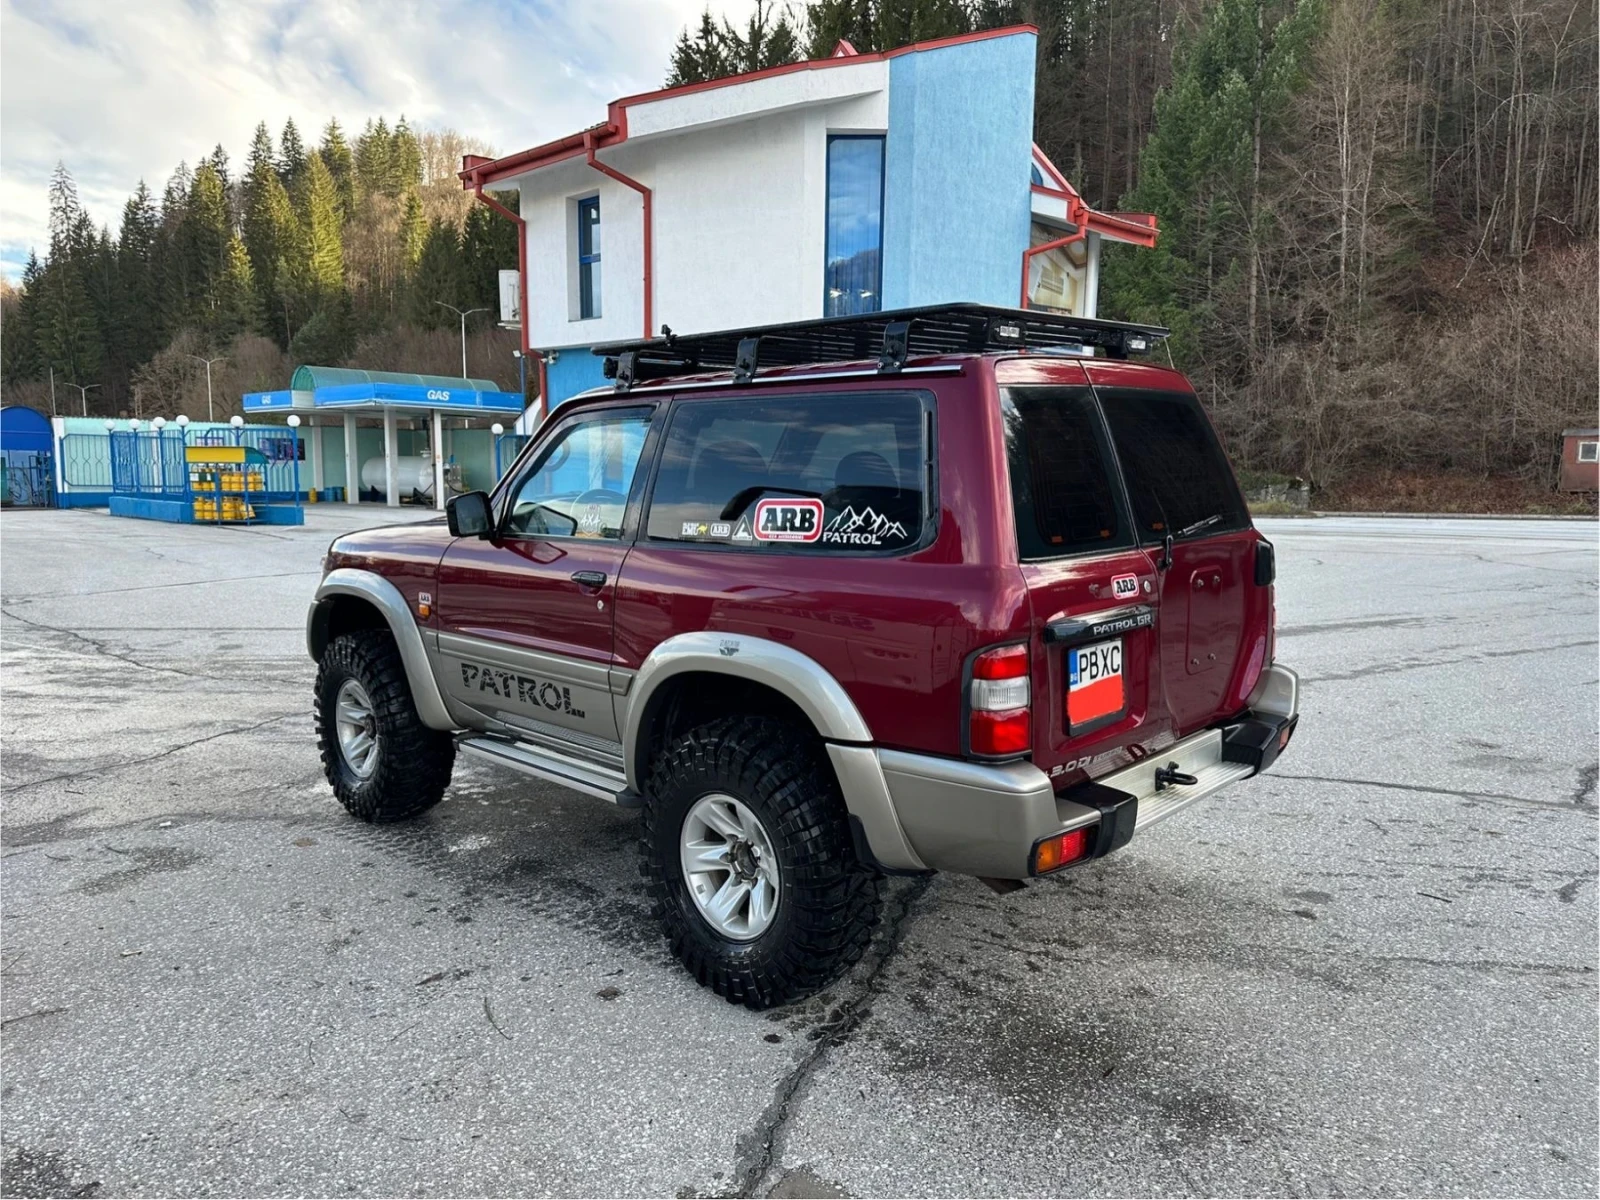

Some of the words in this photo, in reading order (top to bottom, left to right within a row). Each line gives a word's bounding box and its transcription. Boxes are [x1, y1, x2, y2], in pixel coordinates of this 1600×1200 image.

[427, 390, 450, 401] GAS
[761, 507, 816, 533] ARB
[823, 531, 882, 545] PATROL
[1115, 578, 1136, 594] ARB
[1093, 618, 1137, 635] PATROL
[1137, 613, 1151, 625] GR
[460, 662, 585, 719] PATROL
